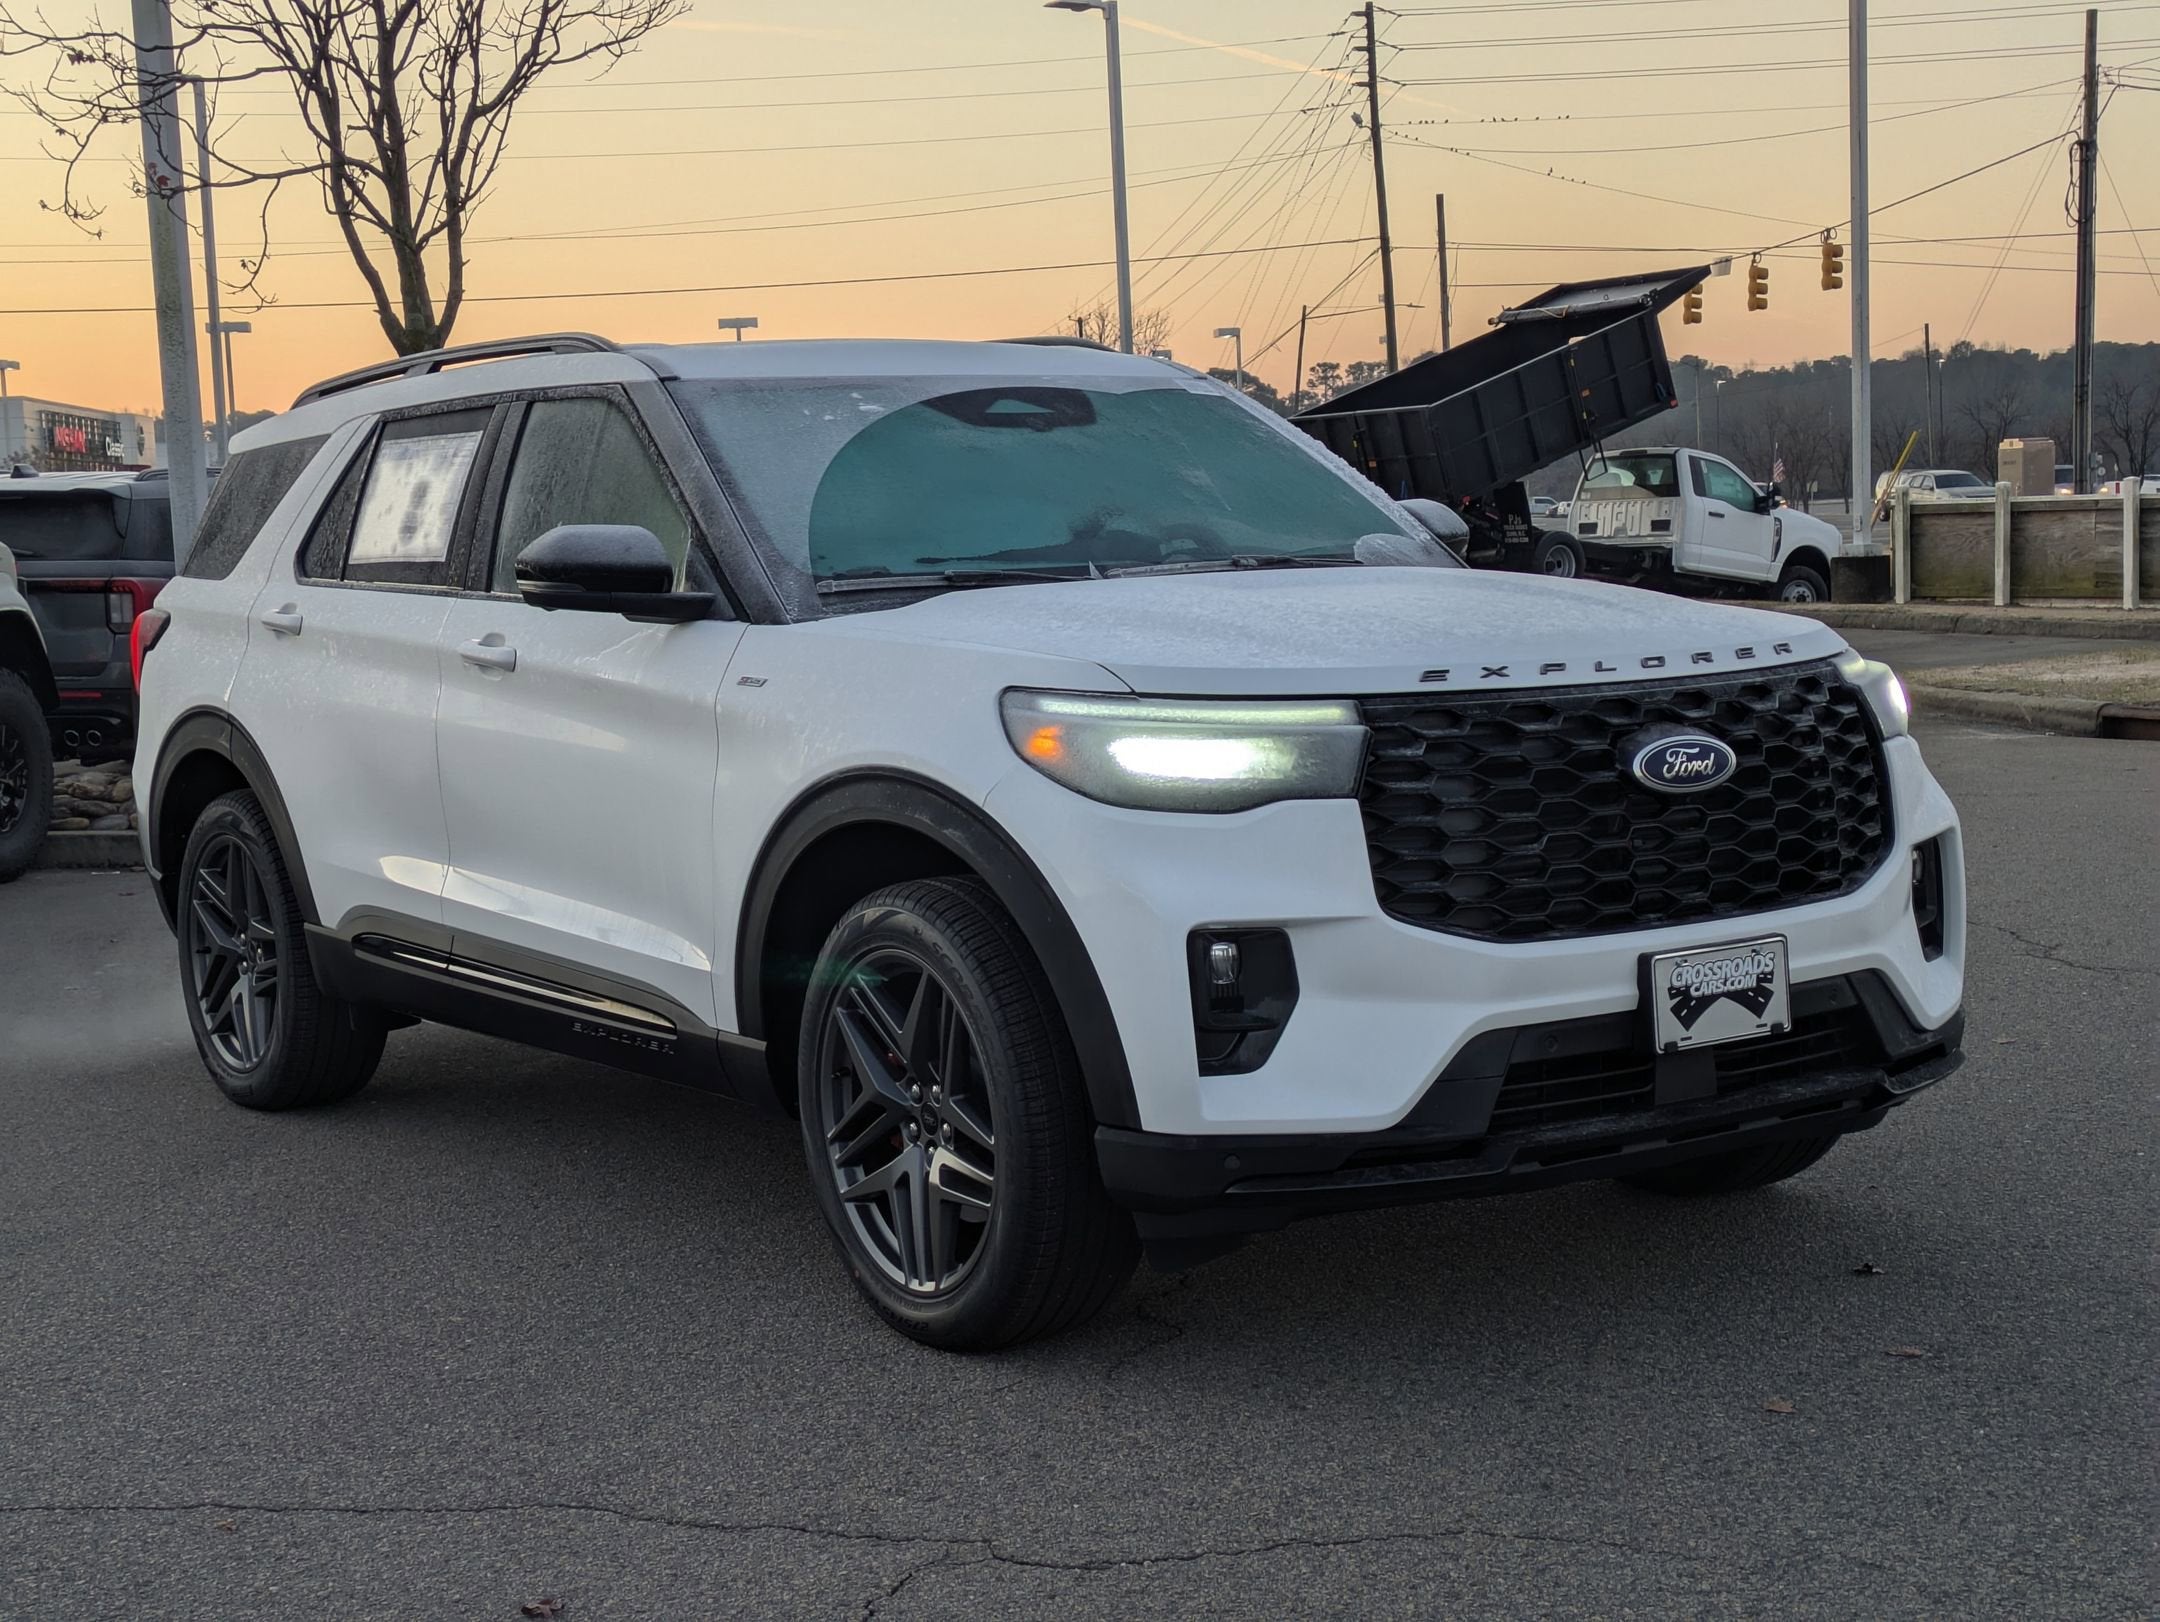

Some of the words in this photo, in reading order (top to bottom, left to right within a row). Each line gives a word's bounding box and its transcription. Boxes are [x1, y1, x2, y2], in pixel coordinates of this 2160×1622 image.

[1419, 642, 1793, 682] EXPLORER
[1663, 747, 1716, 777] Ford
[1670, 952, 1775, 988] CROSSROADS
[1690, 974, 1758, 998] CARS.COM
